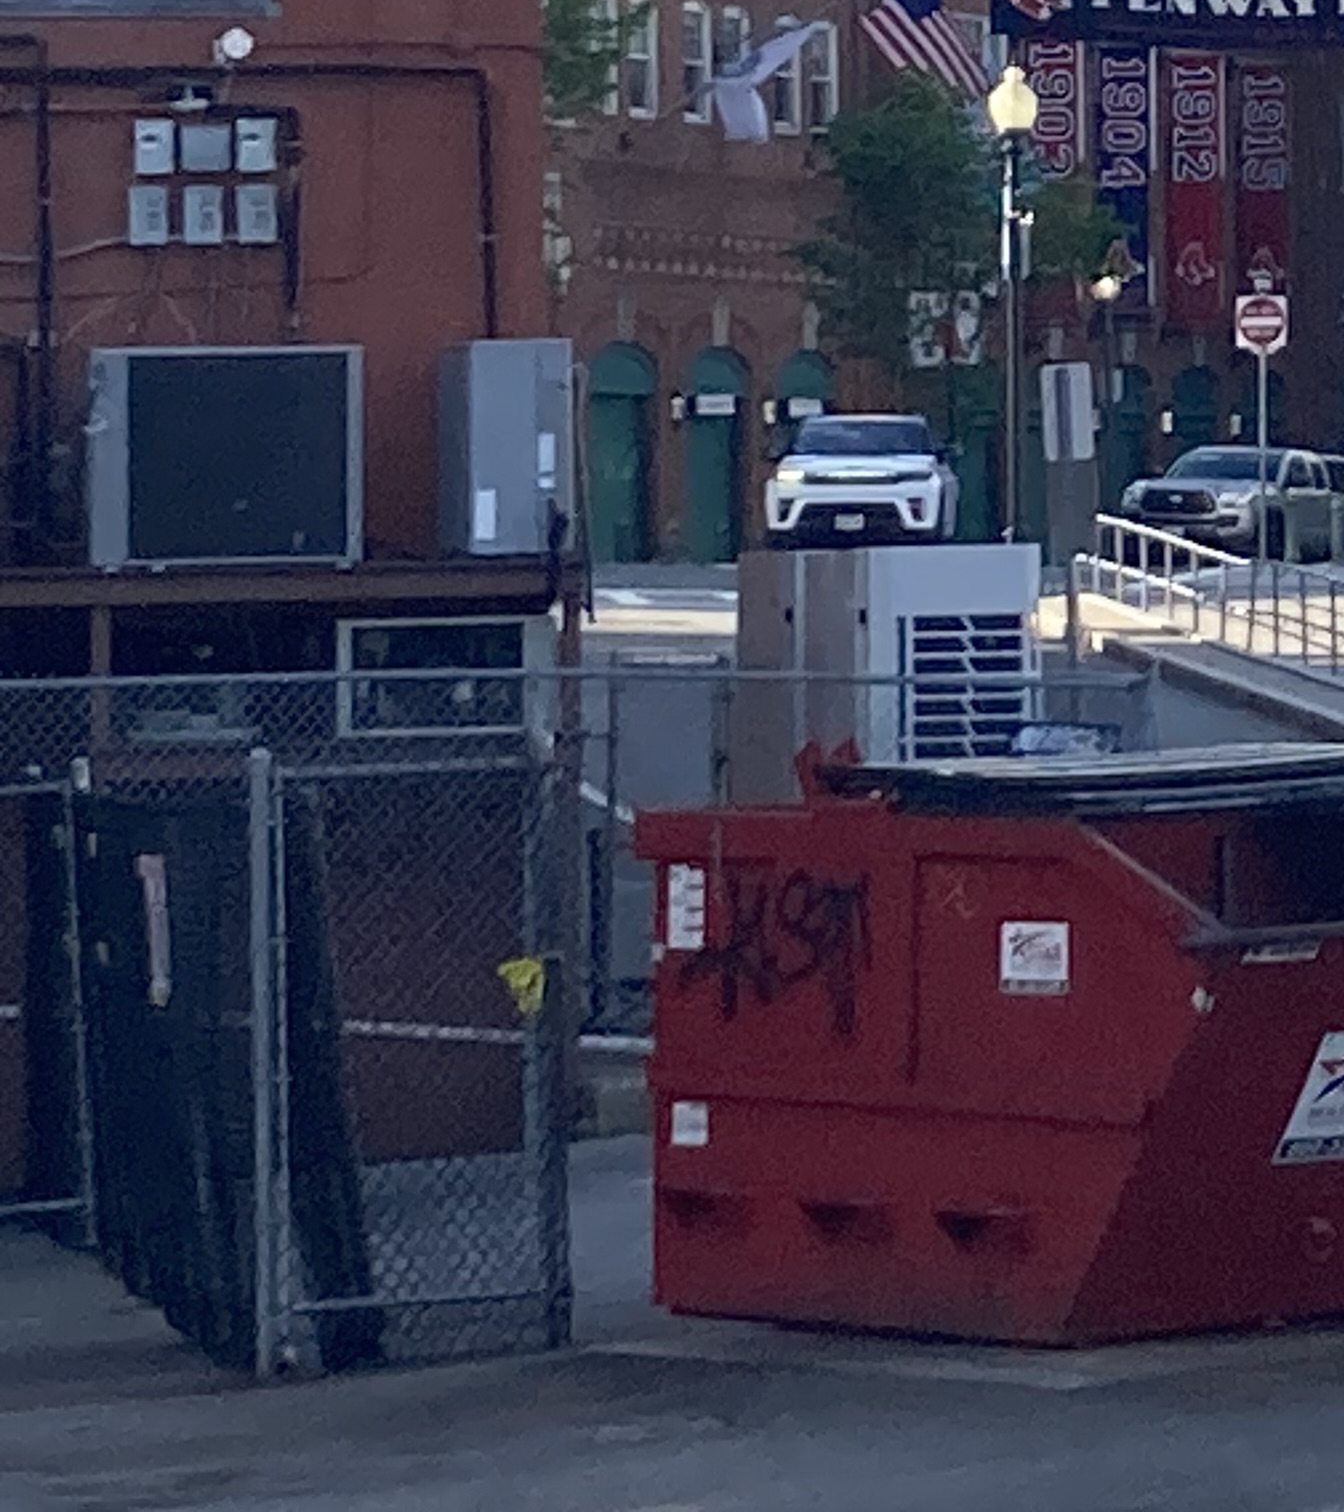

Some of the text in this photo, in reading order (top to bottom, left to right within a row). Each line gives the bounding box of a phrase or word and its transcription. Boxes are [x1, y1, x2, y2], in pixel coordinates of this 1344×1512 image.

[1101, 56, 1147, 189] 1904
[1171, 65, 1218, 183] 1912
[1242, 74, 1286, 191] 1915
